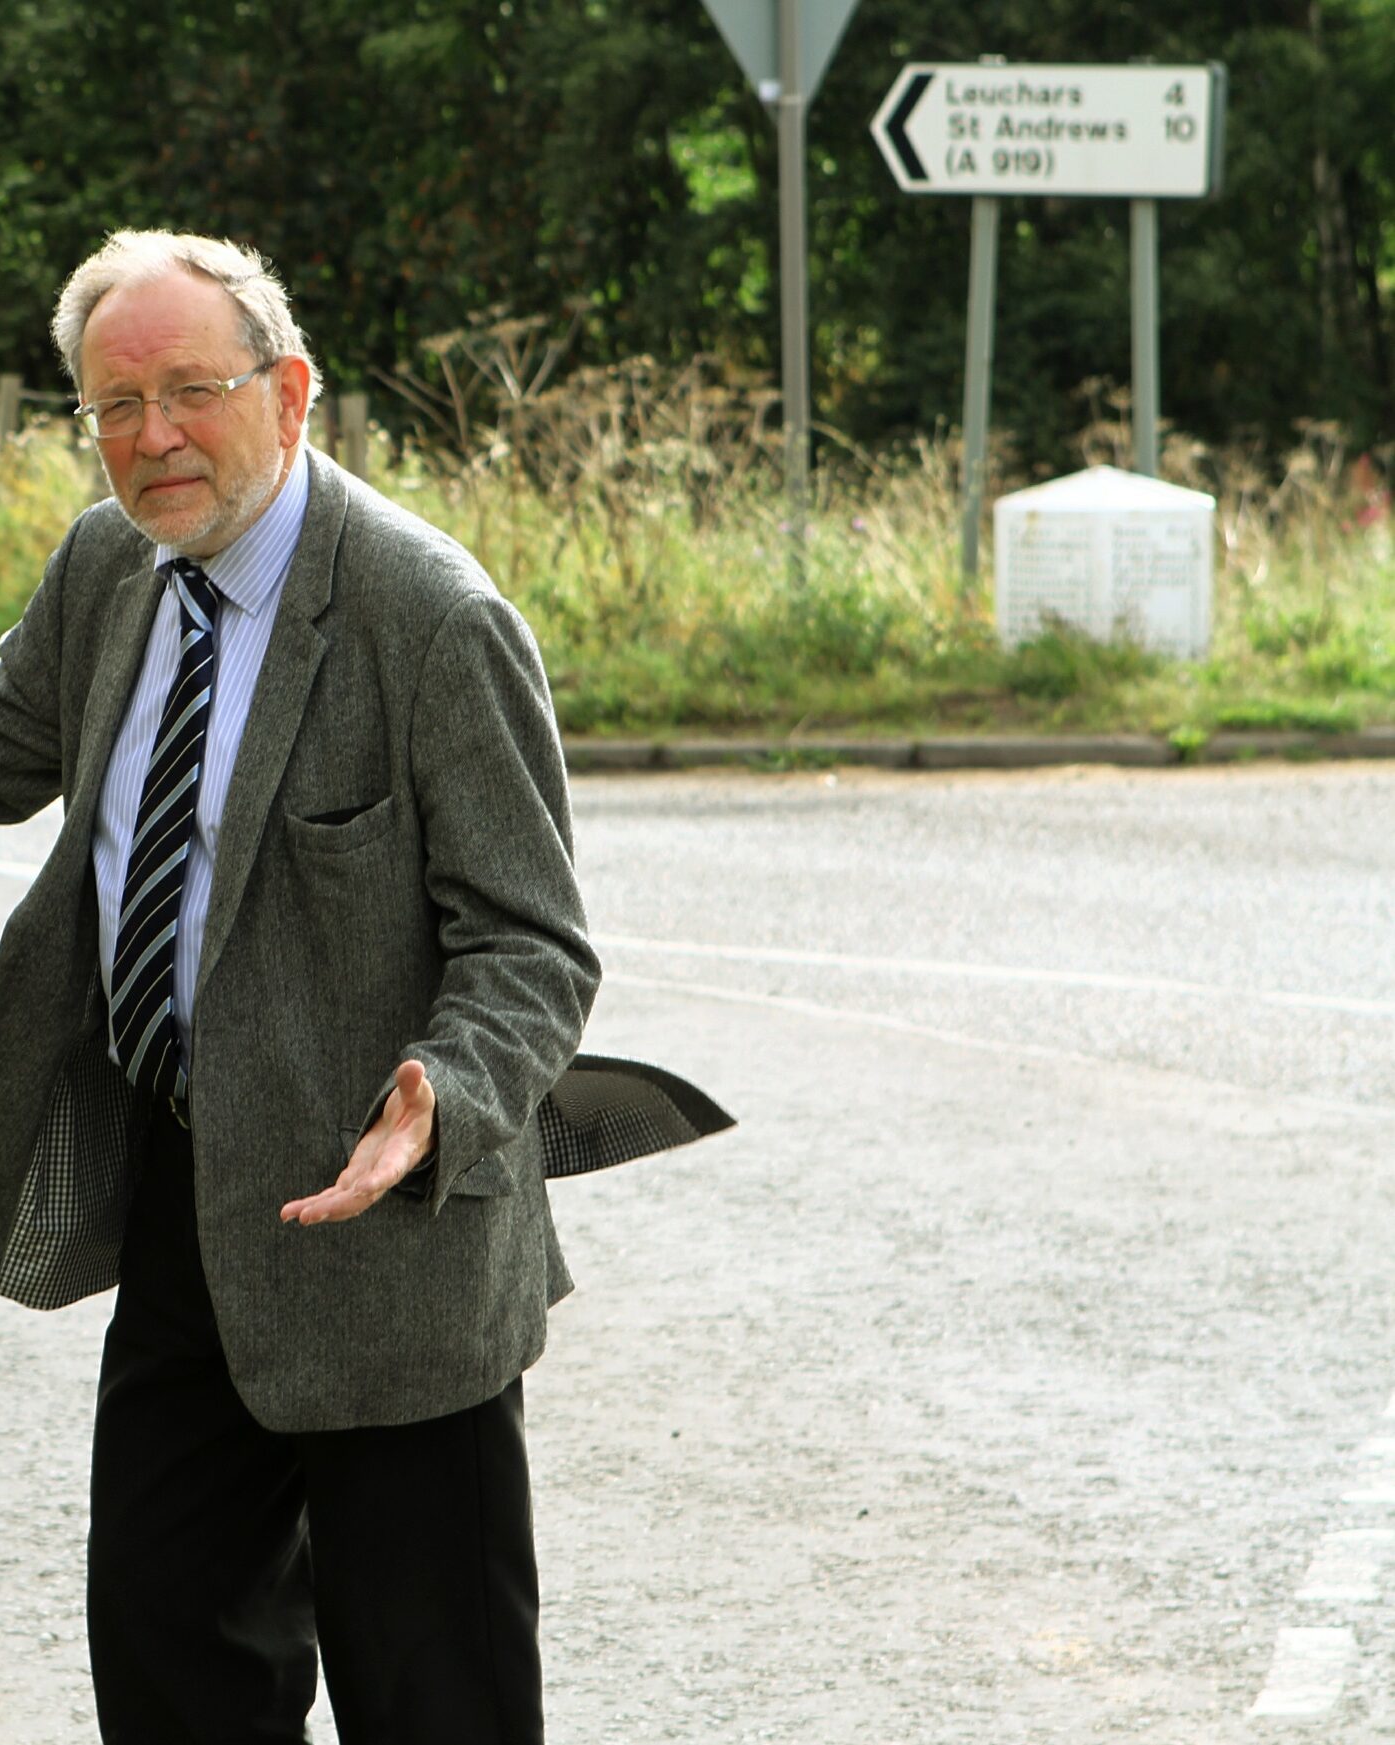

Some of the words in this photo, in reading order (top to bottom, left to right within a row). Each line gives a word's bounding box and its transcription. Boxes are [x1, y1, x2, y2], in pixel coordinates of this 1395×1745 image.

[945, 81, 1083, 107] Leuchars
[1163, 82, 1186, 107] 4
[948, 114, 980, 140] St
[995, 114, 1127, 141] Andrews
[1163, 115, 1197, 142] 10
[944, 147, 978, 178] (A
[992, 148, 1055, 178] 919)
